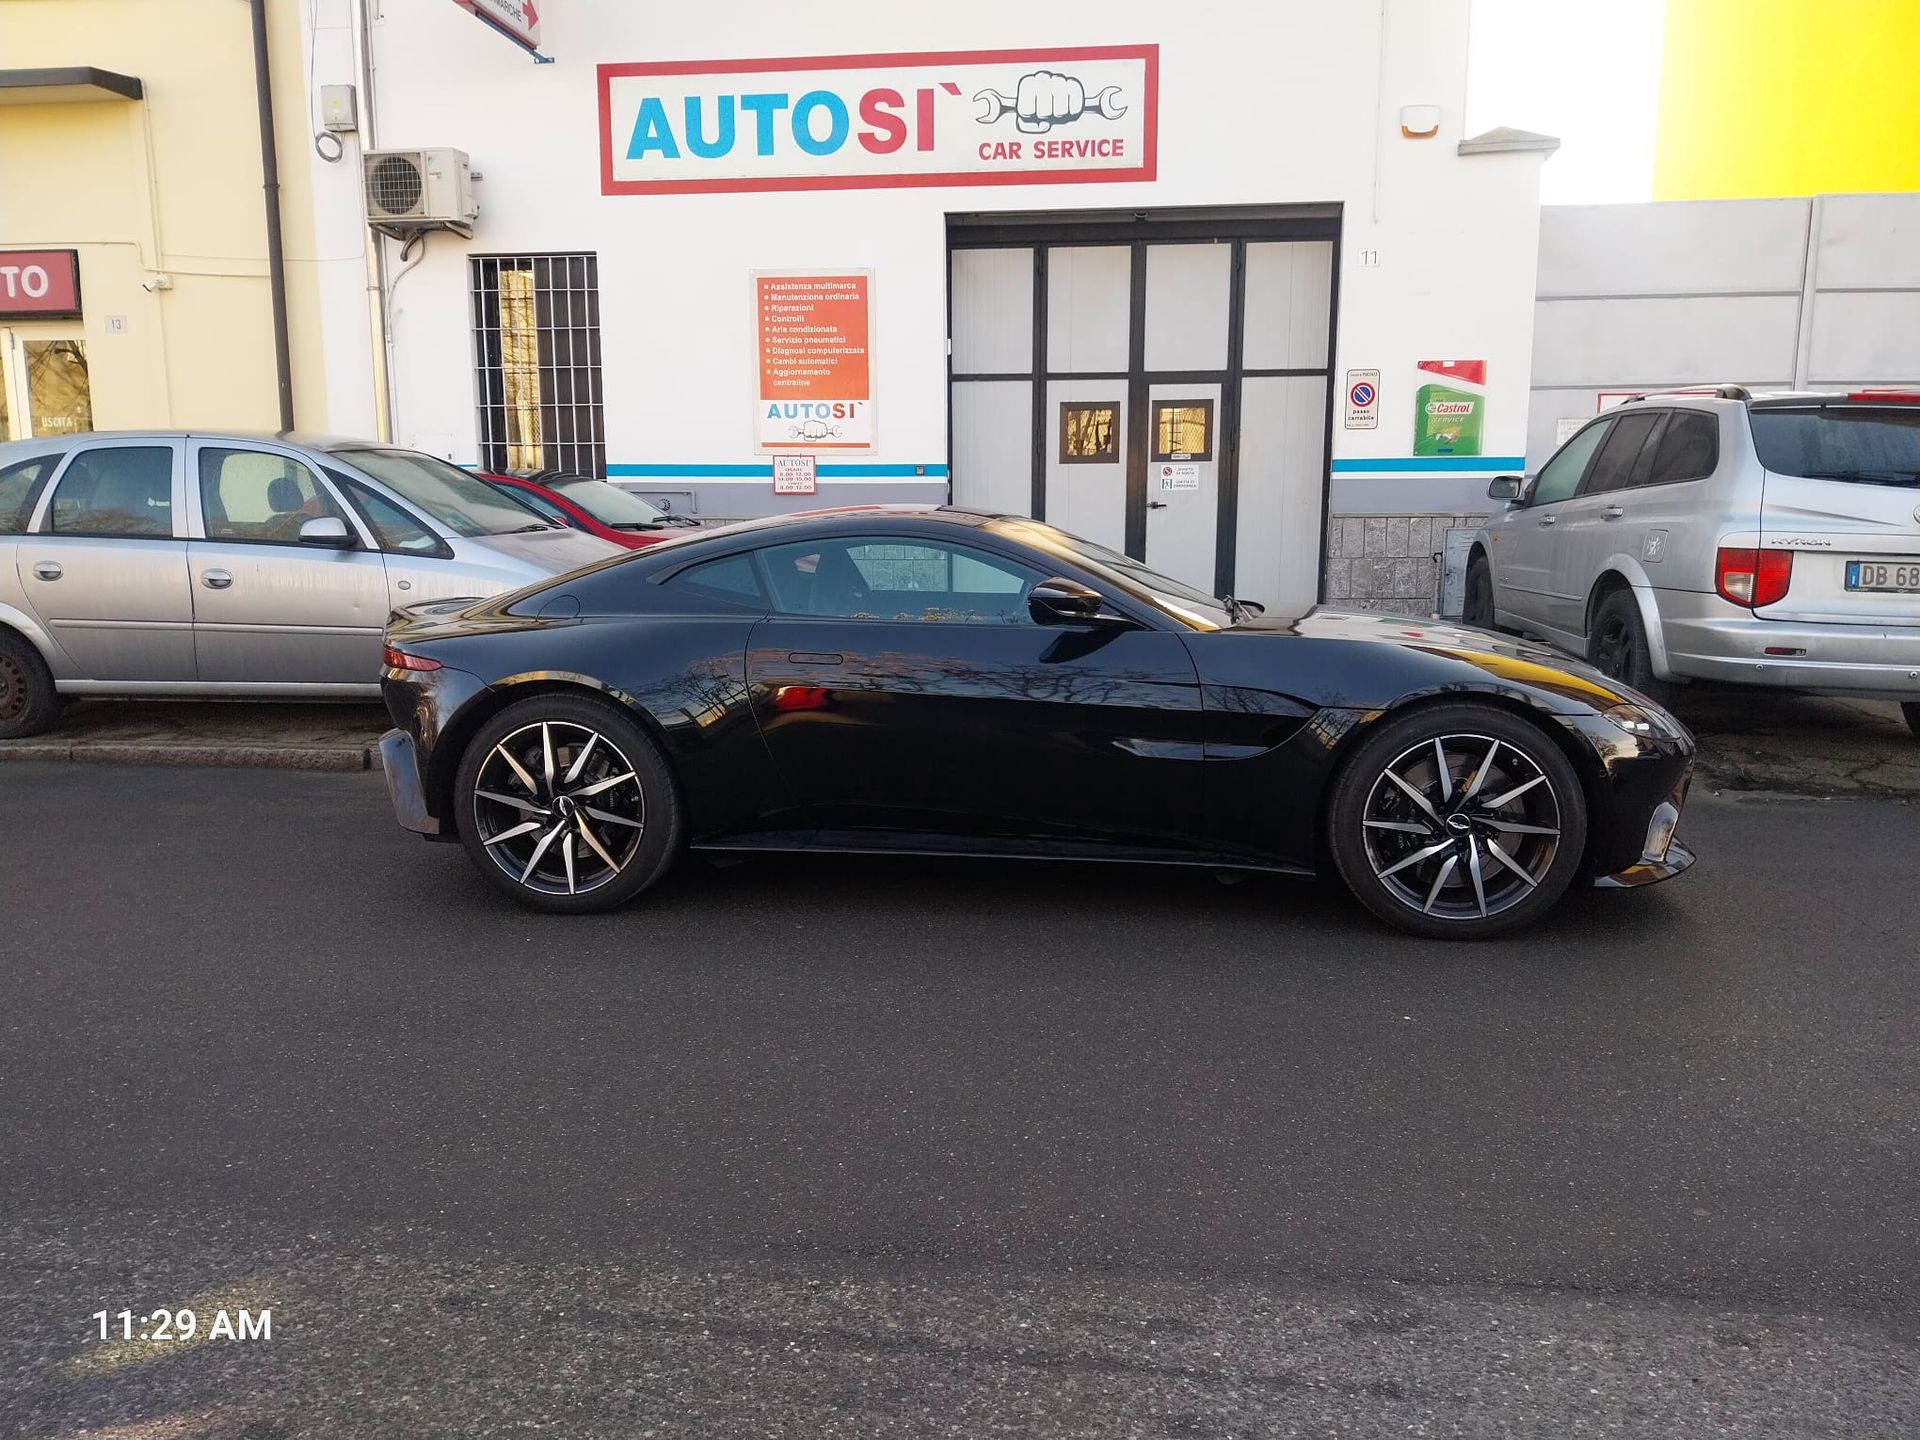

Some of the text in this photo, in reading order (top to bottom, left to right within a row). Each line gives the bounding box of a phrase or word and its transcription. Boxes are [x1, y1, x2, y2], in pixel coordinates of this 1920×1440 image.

[978, 138, 1124, 161] CAR SERVICE
[1361, 251, 1377, 265] 11
[770, 282, 856, 290] Assistenza multimarca
[771, 293, 824, 301] Manutenzione
[771, 304, 814, 313] Riparazioni
[771, 315, 804, 323] Controlli
[111, 319, 122, 330] 13
[772, 325, 837, 333] Aria condizionata
[772, 336, 846, 346] Servizio pneumatici
[772, 347, 865, 356] Diagnosi computerizzata
[772, 357, 838, 365] Cambi automatici
[773, 368, 831, 378] Aggiornamento
[773, 379, 811, 387] centraline
[1436, 402, 1471, 414] Castrol
[41, 416, 73, 428] USCITA
[1771, 537, 1832, 547] KYRON
[1862, 565, 1920, 587] DB 68
